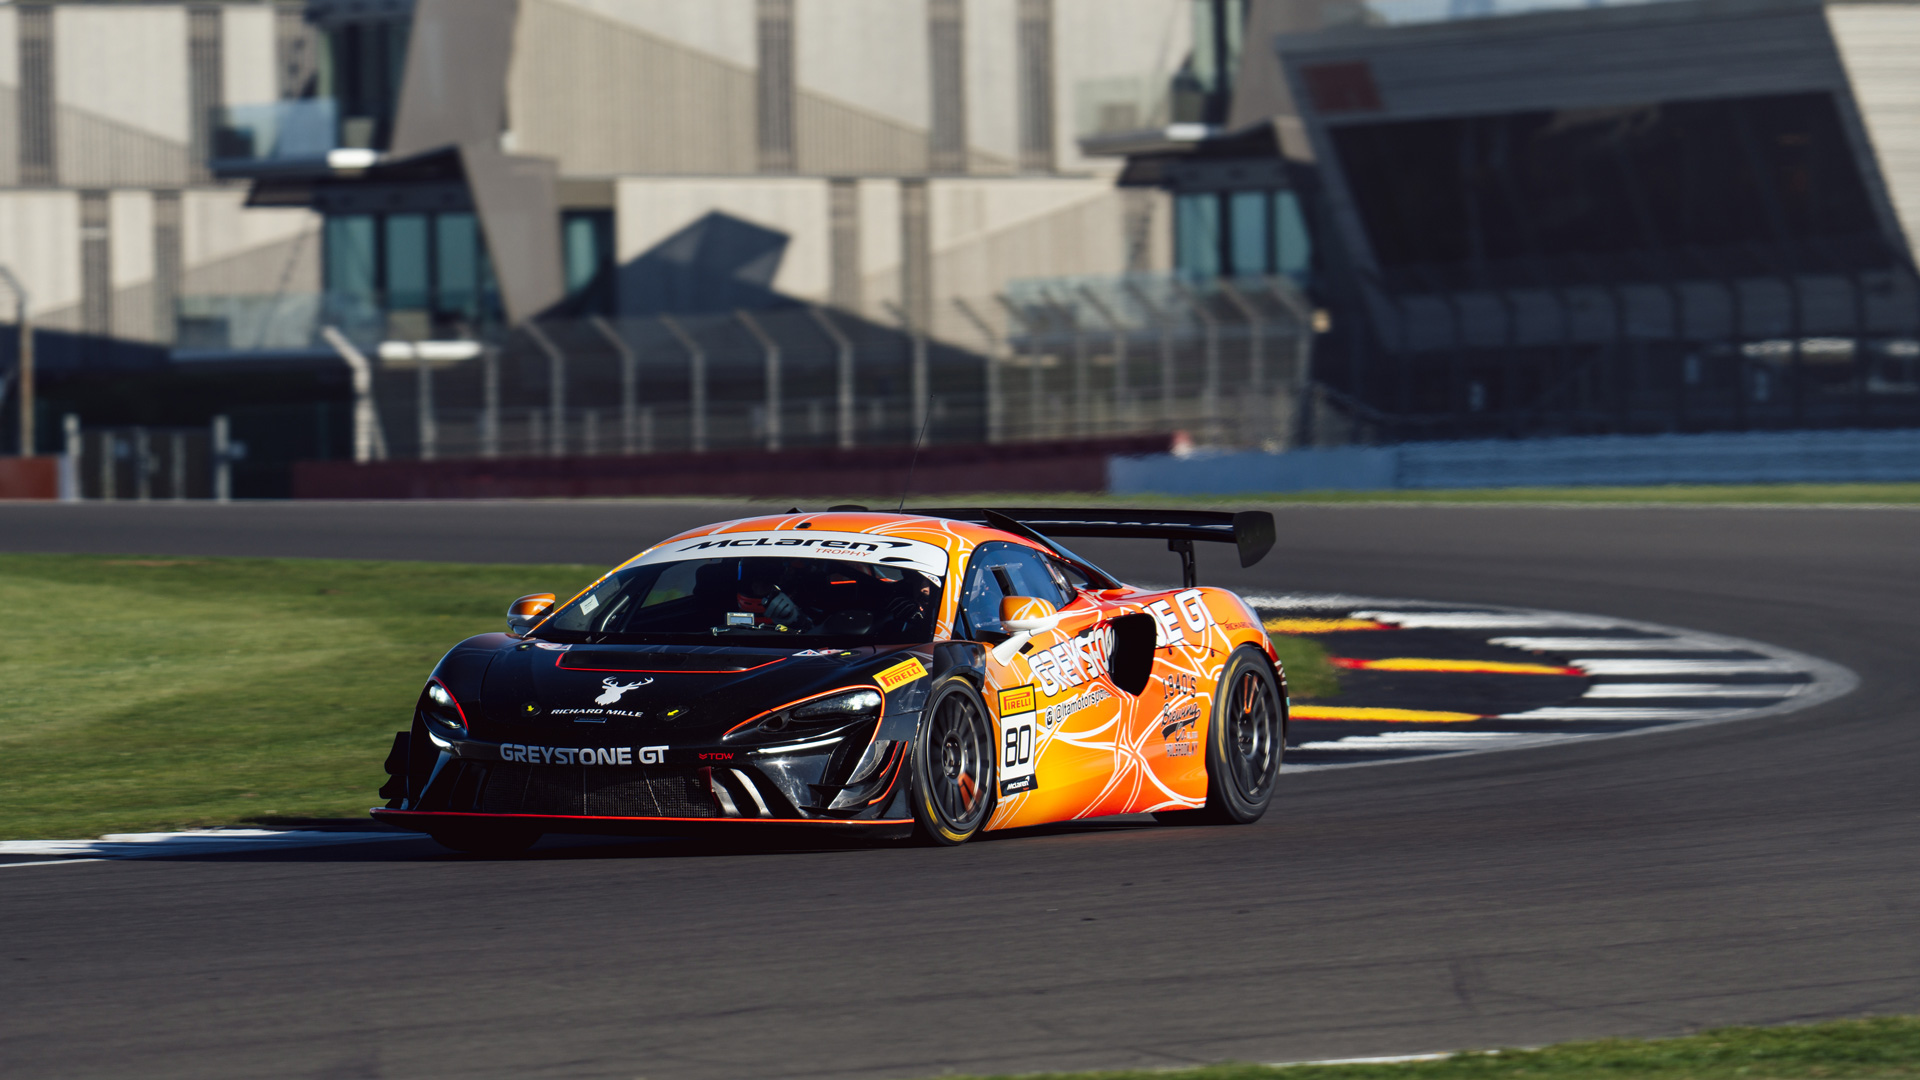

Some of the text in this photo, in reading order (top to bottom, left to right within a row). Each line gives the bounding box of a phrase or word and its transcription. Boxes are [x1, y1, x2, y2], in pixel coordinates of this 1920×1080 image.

[676, 537, 885, 552] McLaren
[815, 548, 871, 558] TROPHY
[1174, 588, 1216, 633] GT
[881, 662, 922, 688] PIRELLI
[1003, 691, 1032, 711] PIRELLI
[551, 708, 644, 718] RICHARD MILLE
[1160, 702, 1201, 729] Brewing
[500, 743, 669, 765] GREYSTONE GT
[1005, 724, 1031, 768] 80
